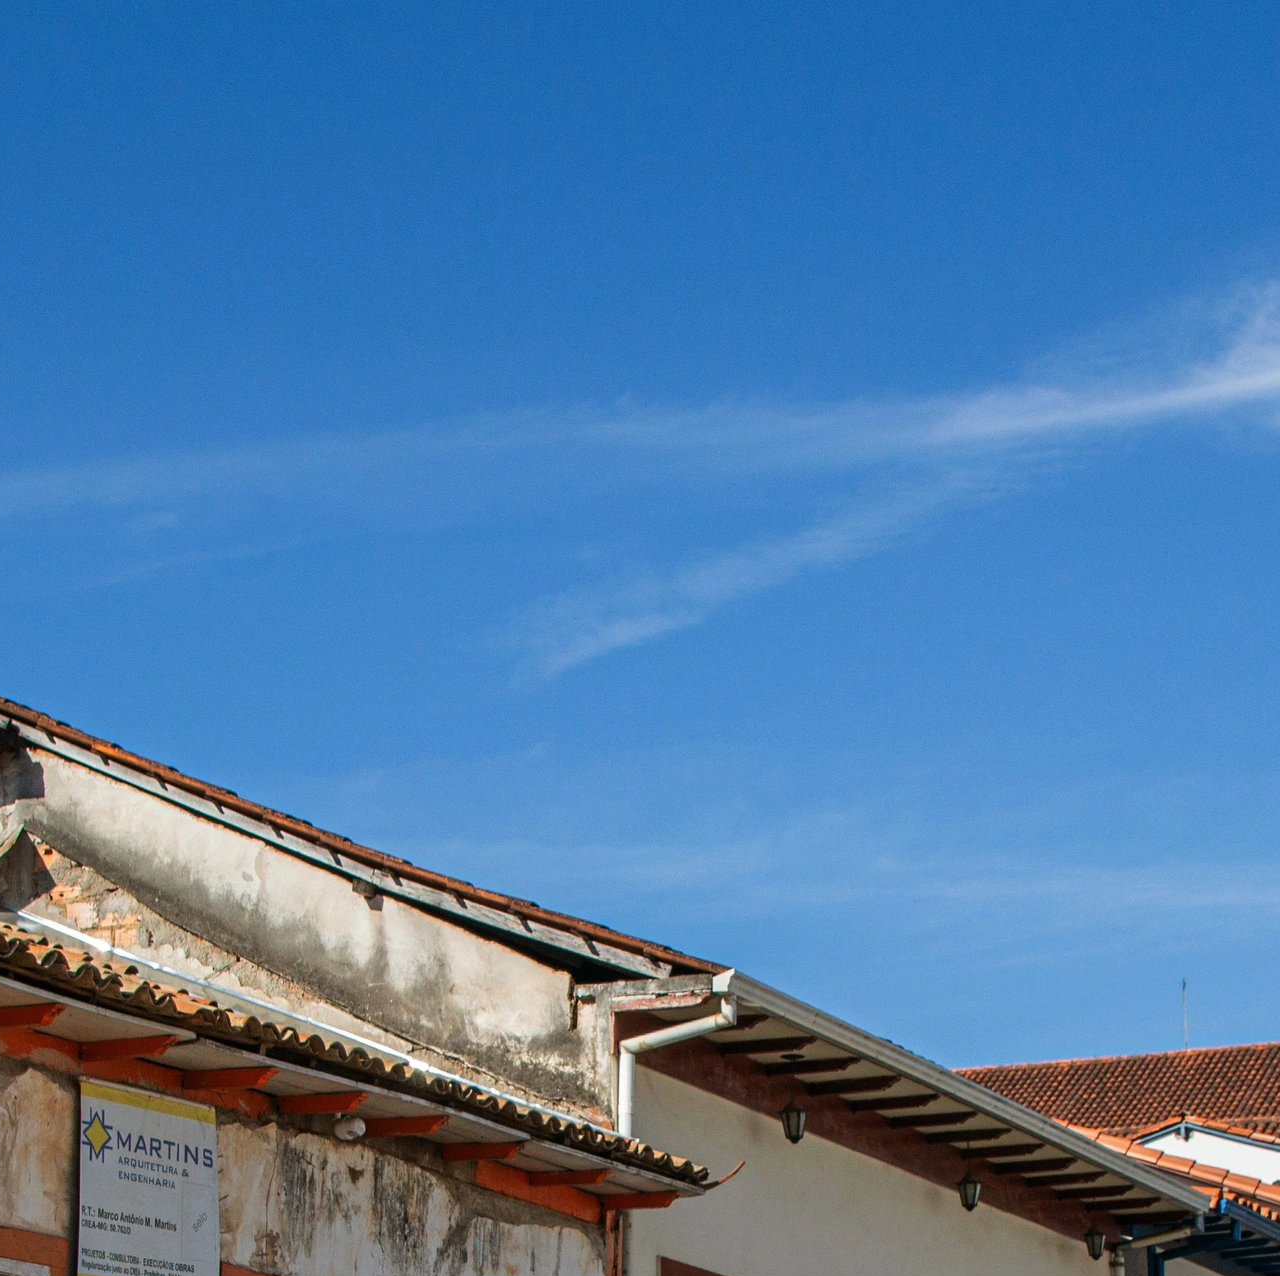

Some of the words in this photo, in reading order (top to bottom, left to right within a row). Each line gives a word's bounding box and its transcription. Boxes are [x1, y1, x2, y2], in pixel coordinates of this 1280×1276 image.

[117, 1130, 213, 1168] MARTINS
[118, 1156, 178, 1176] ARQUITETURA
[181, 1168, 189, 1177] &
[118, 1170, 176, 1190] ENGENHARIA
[98, 1208, 119, 1221] Marco
[120, 1212, 144, 1226] Antônio
[144, 1217, 153, 1228] M.
[154, 1218, 177, 1232] Martins
[192, 1212, 208, 1232] selo
[81, 1247, 106, 1260] PROJETOS
[175, 1261, 195, 1274] OBRAS
[129, 1267, 141, 1276] CREA
